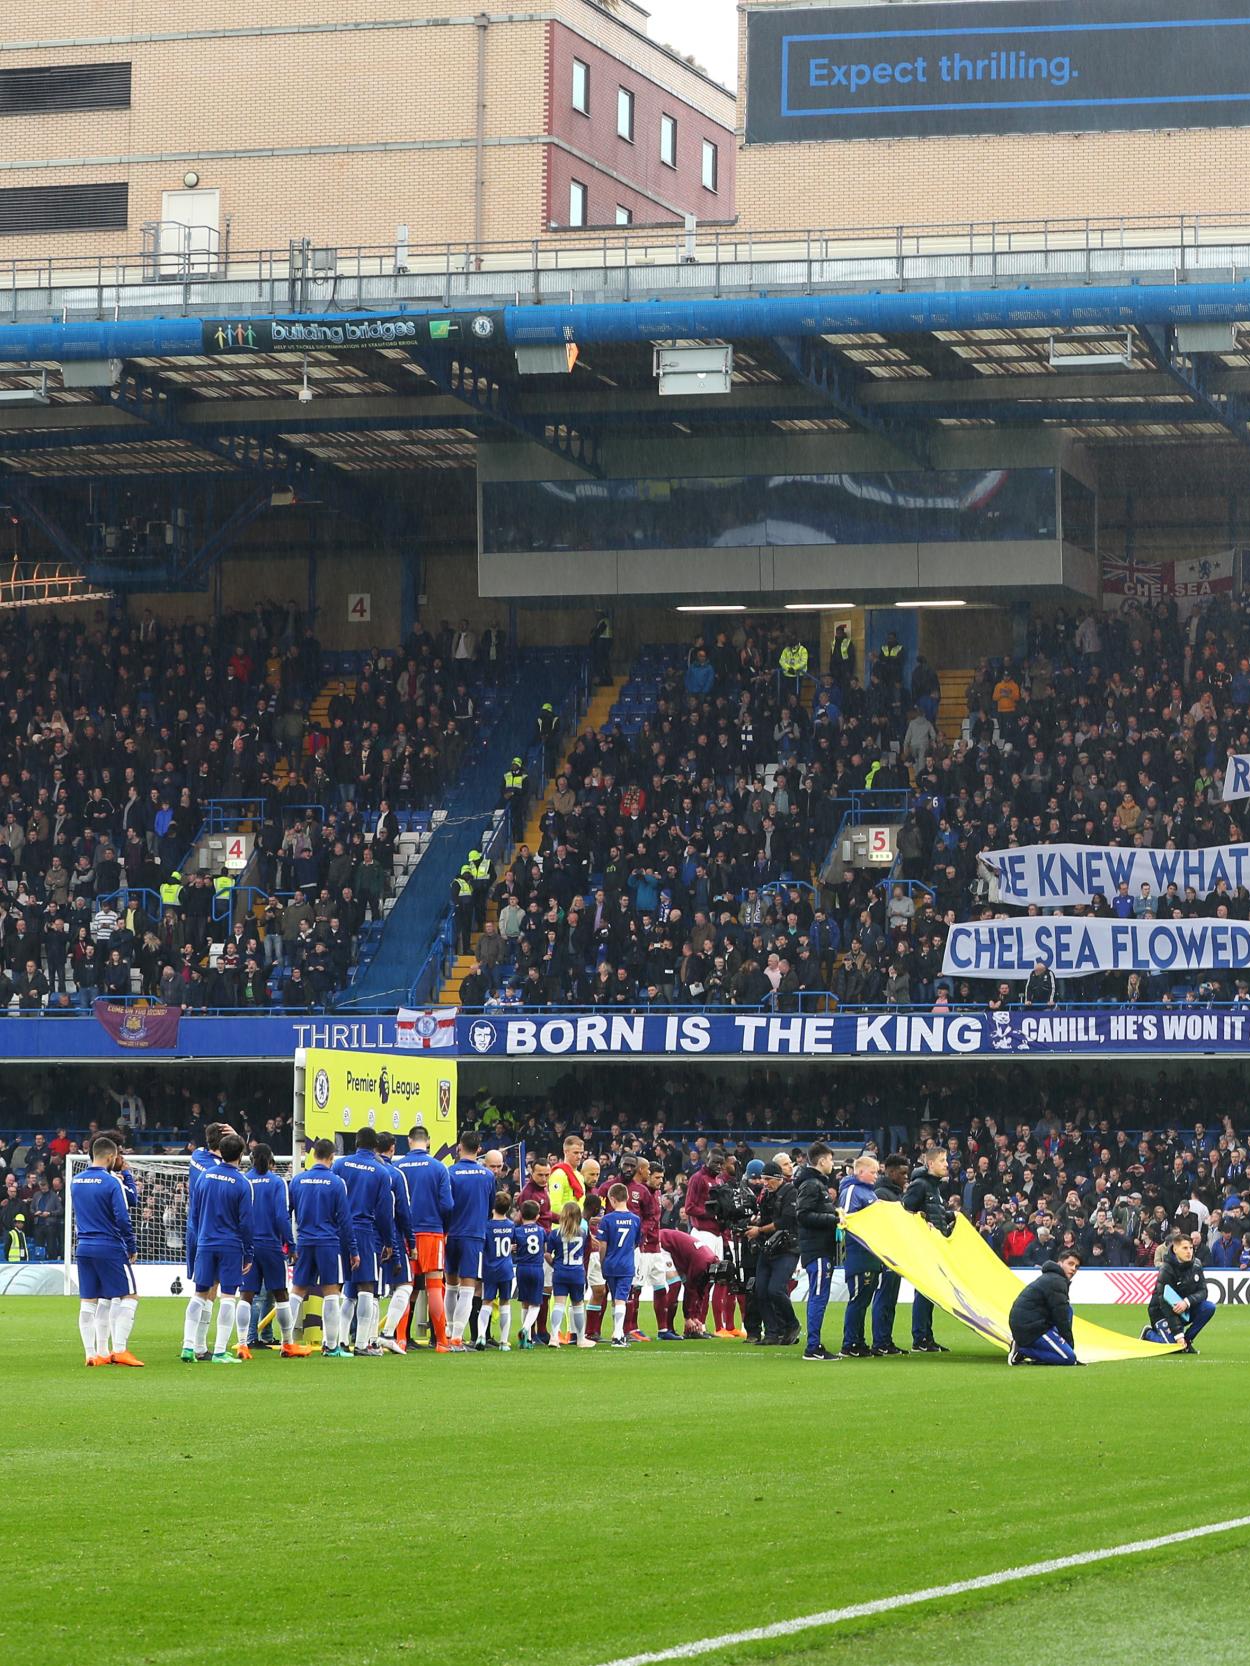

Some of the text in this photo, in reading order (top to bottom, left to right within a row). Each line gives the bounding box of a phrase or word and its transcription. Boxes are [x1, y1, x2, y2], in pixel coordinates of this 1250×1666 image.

[809, 51, 1079, 92] Expect thrilling.
[271, 321, 416, 344] building bridges
[351, 597, 367, 617] 4
[229, 839, 242, 858] 4
[873, 831, 886, 851] 5
[1037, 852, 1137, 896] KNEW
[1150, 848, 1249, 892] WHAT
[949, 925, 1100, 970] CHELSEA
[506, 1015, 983, 1054] BORN IS THE KING
[1021, 1016, 1105, 1044] CAHILL,
[1110, 1015, 1158, 1041] HE'S
[1162, 1015, 1218, 1041] WON
[1224, 1016, 1246, 1041] IT
[347, 1071, 420, 1100] Premier League
[205, 1173, 228, 1181] CHELSEA
[344, 1162, 367, 1170] CHELSEA
[494, 1237, 511, 1258] 10
[527, 1235, 540, 1255] 8
[617, 1228, 630, 1247] 7
[562, 1236, 584, 1266] 12
